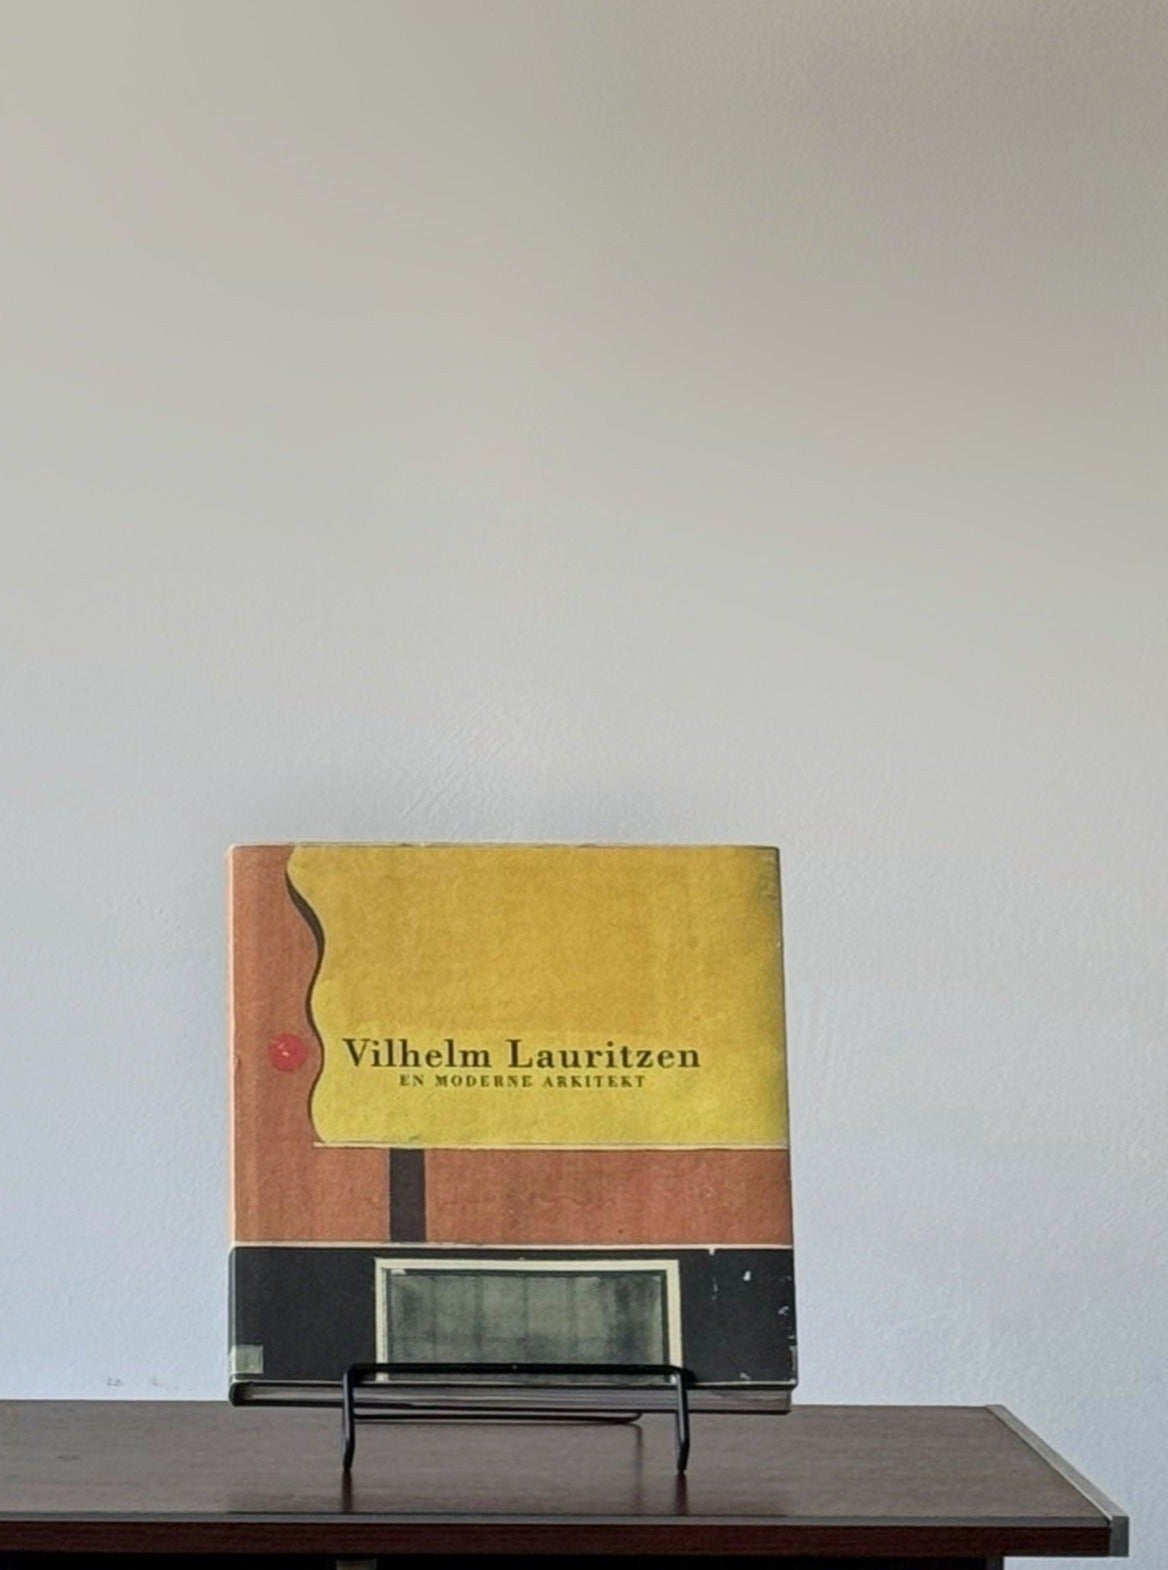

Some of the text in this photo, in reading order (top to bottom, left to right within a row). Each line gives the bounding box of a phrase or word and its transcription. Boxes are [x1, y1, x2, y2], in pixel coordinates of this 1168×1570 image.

[342, 1037, 702, 1069] Vilhelm Lauritzen
[399, 1074, 647, 1089] EN MODERNE ARKITEKT
